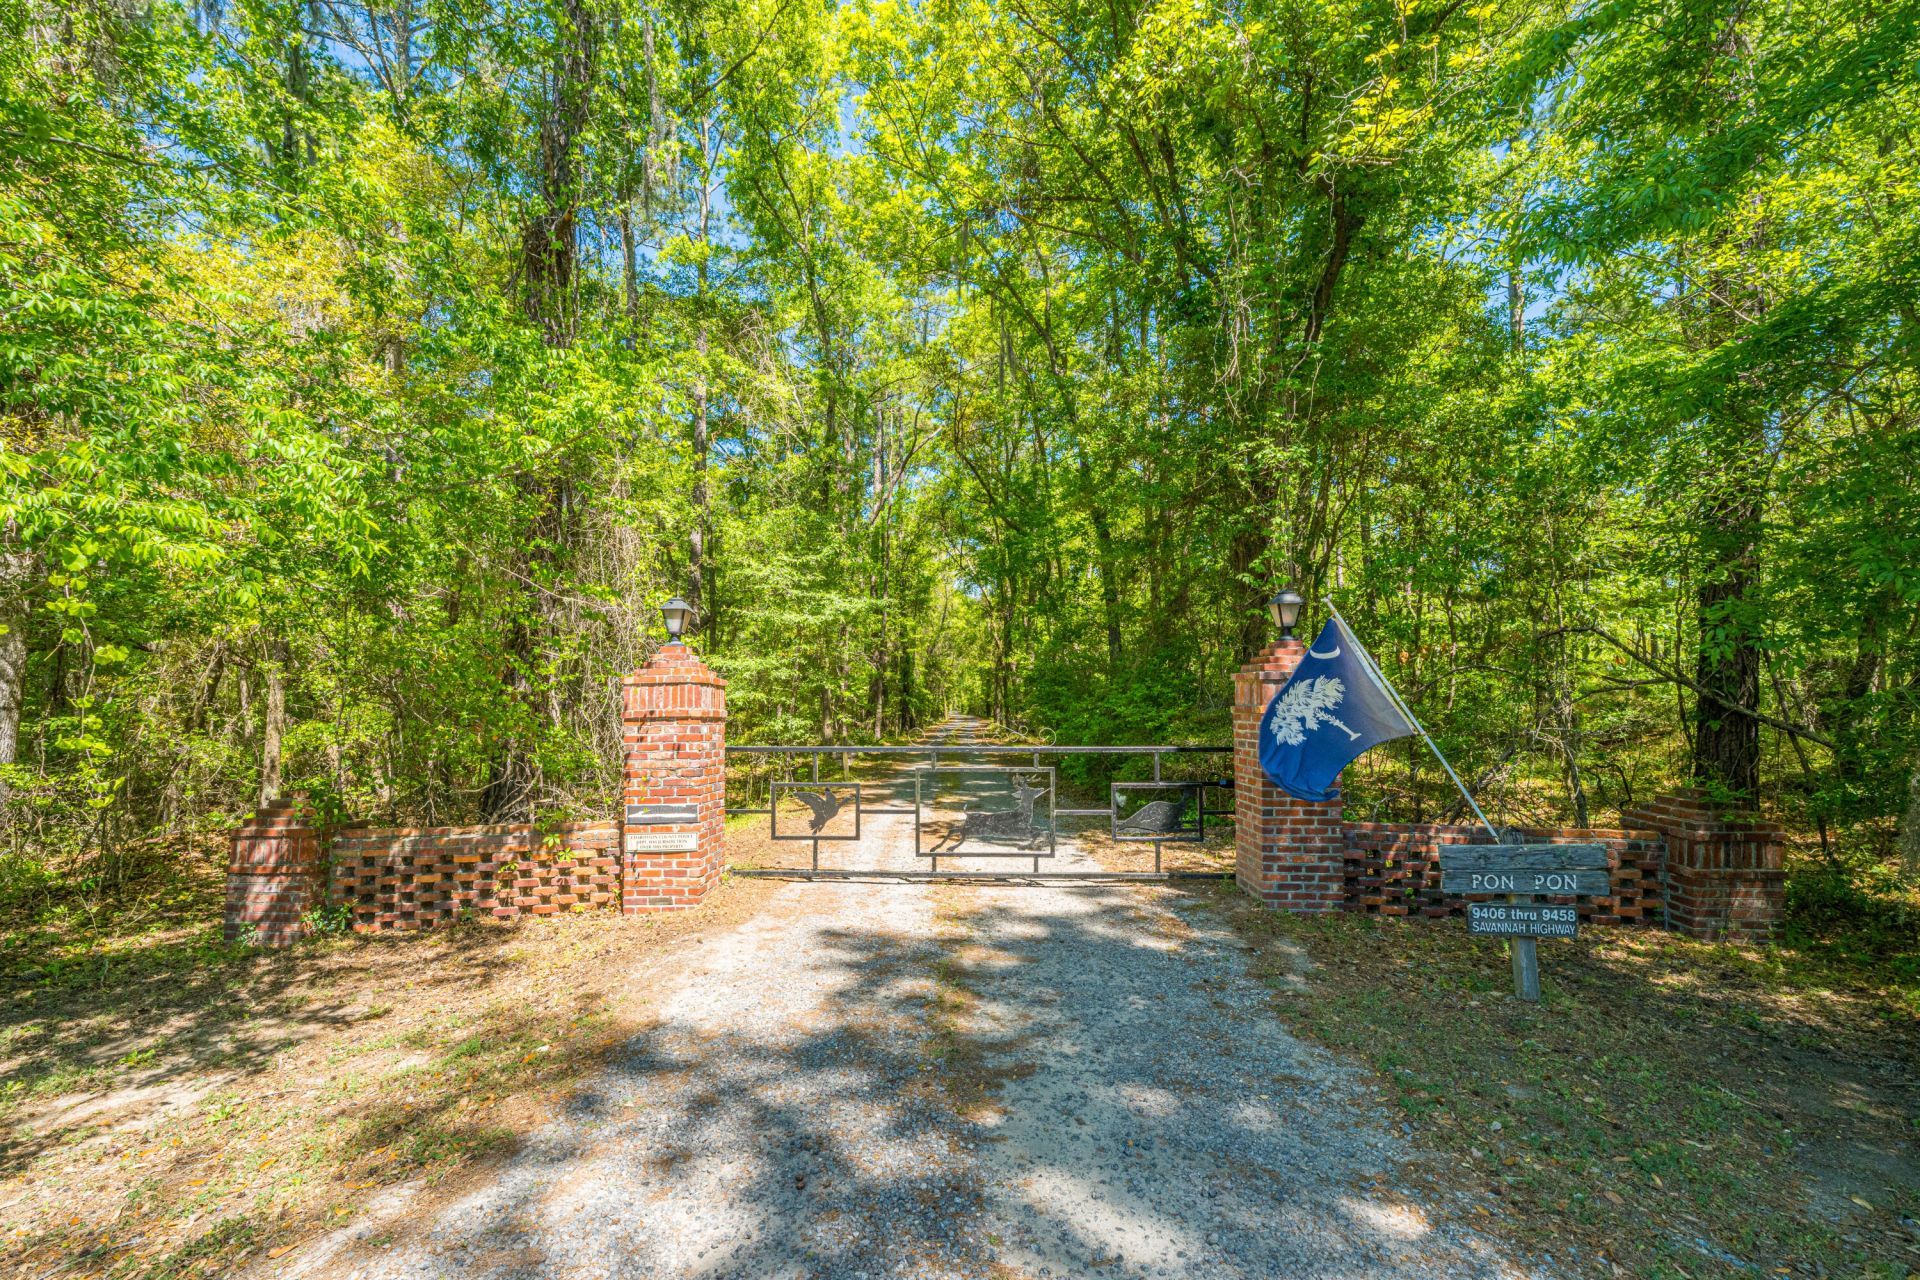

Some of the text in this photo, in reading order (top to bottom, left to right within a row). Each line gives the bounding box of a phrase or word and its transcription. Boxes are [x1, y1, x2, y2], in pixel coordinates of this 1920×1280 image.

[1472, 874, 1577, 890] PON PON
[1472, 907, 1576, 922] 9406 thru 9458
[1472, 921, 1576, 935] SAVANNAH HIGHWAY
